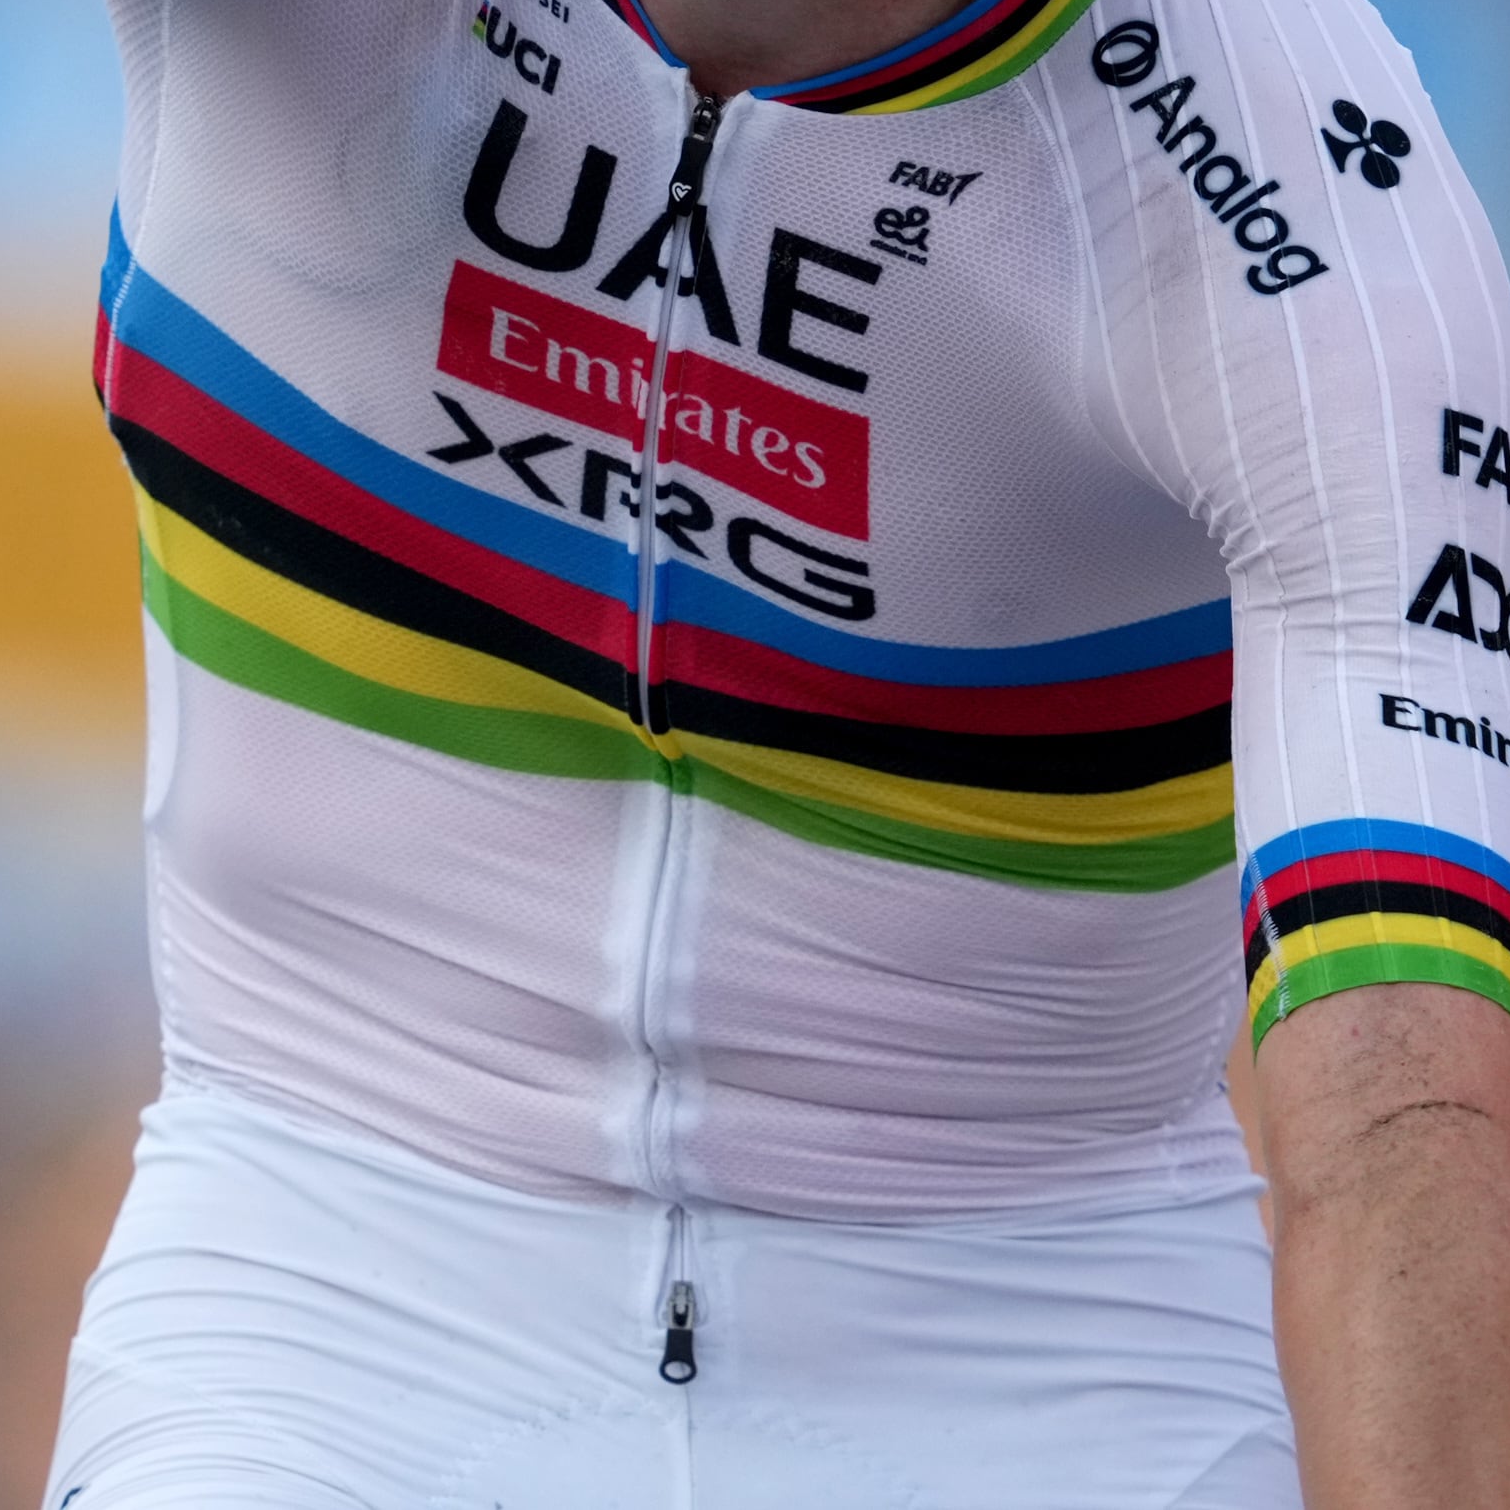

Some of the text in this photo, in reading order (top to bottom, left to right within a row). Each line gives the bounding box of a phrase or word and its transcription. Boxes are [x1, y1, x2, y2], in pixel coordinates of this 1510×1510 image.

[486, 6, 561, 95] UCI
[463, 98, 882, 393] UAE
[1129, 76, 1329, 294] Analog
[426, 391, 875, 621] XRG
[490, 306, 826, 489] Emirates
